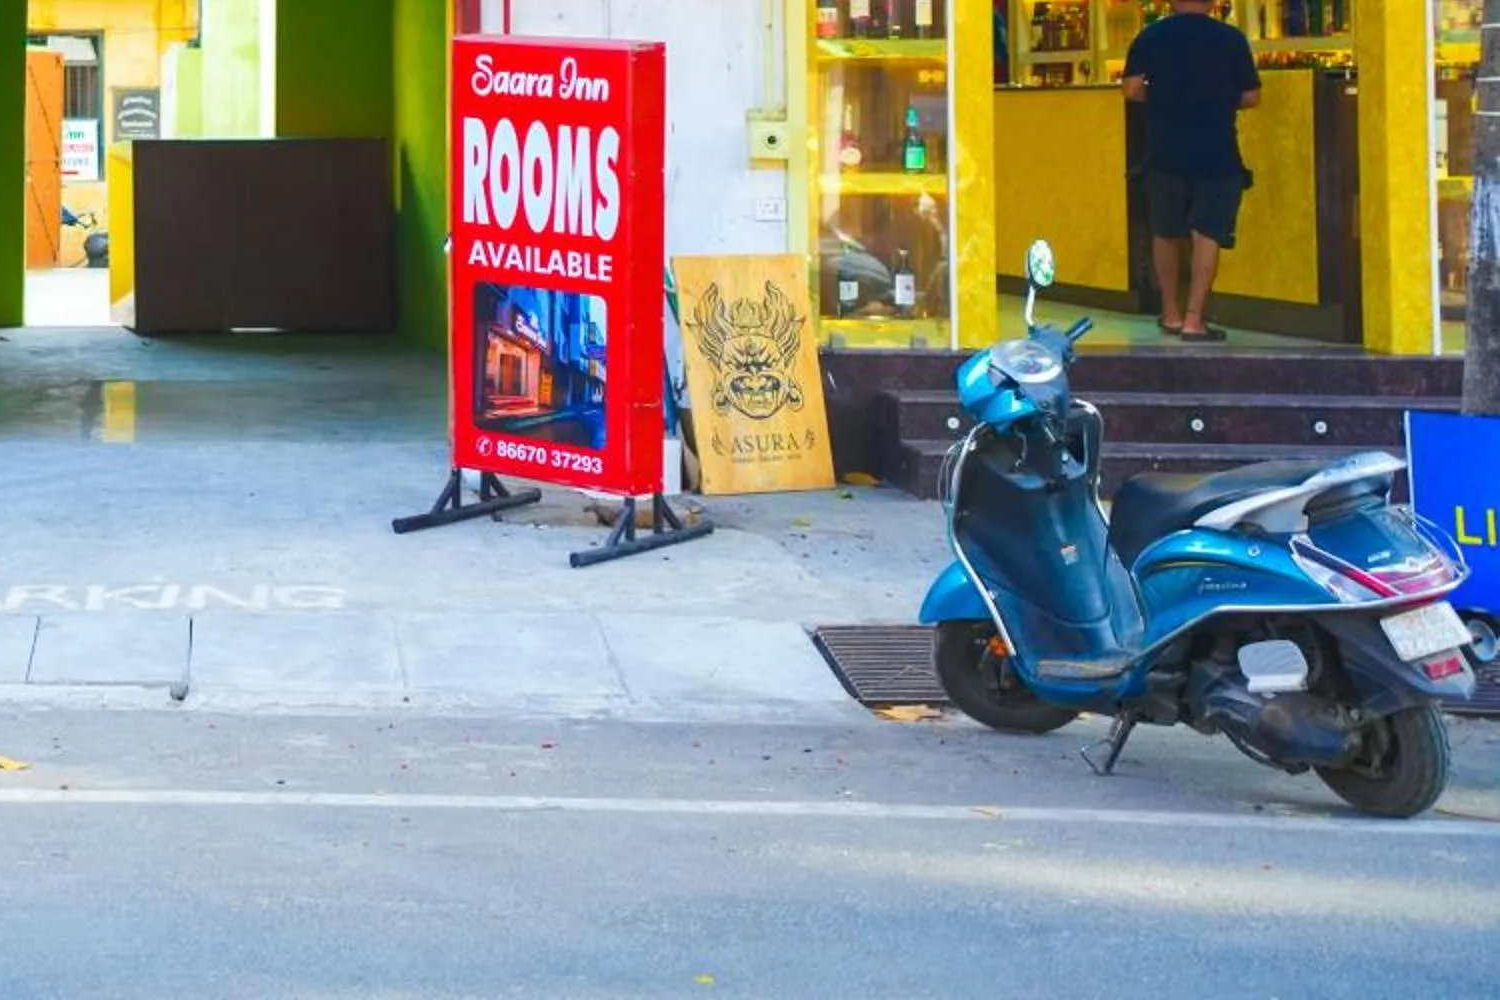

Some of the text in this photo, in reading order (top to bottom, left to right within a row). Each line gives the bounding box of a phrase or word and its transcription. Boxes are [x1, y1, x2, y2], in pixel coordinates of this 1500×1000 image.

[471, 54, 609, 102] Saara Inn
[463, 117, 620, 241] ROOMS
[468, 239, 613, 282] AVAILABLE
[497, 440, 603, 474] 86670 37293
[731, 432, 800, 453] ASURA
[1455, 505, 1497, 546] LI
